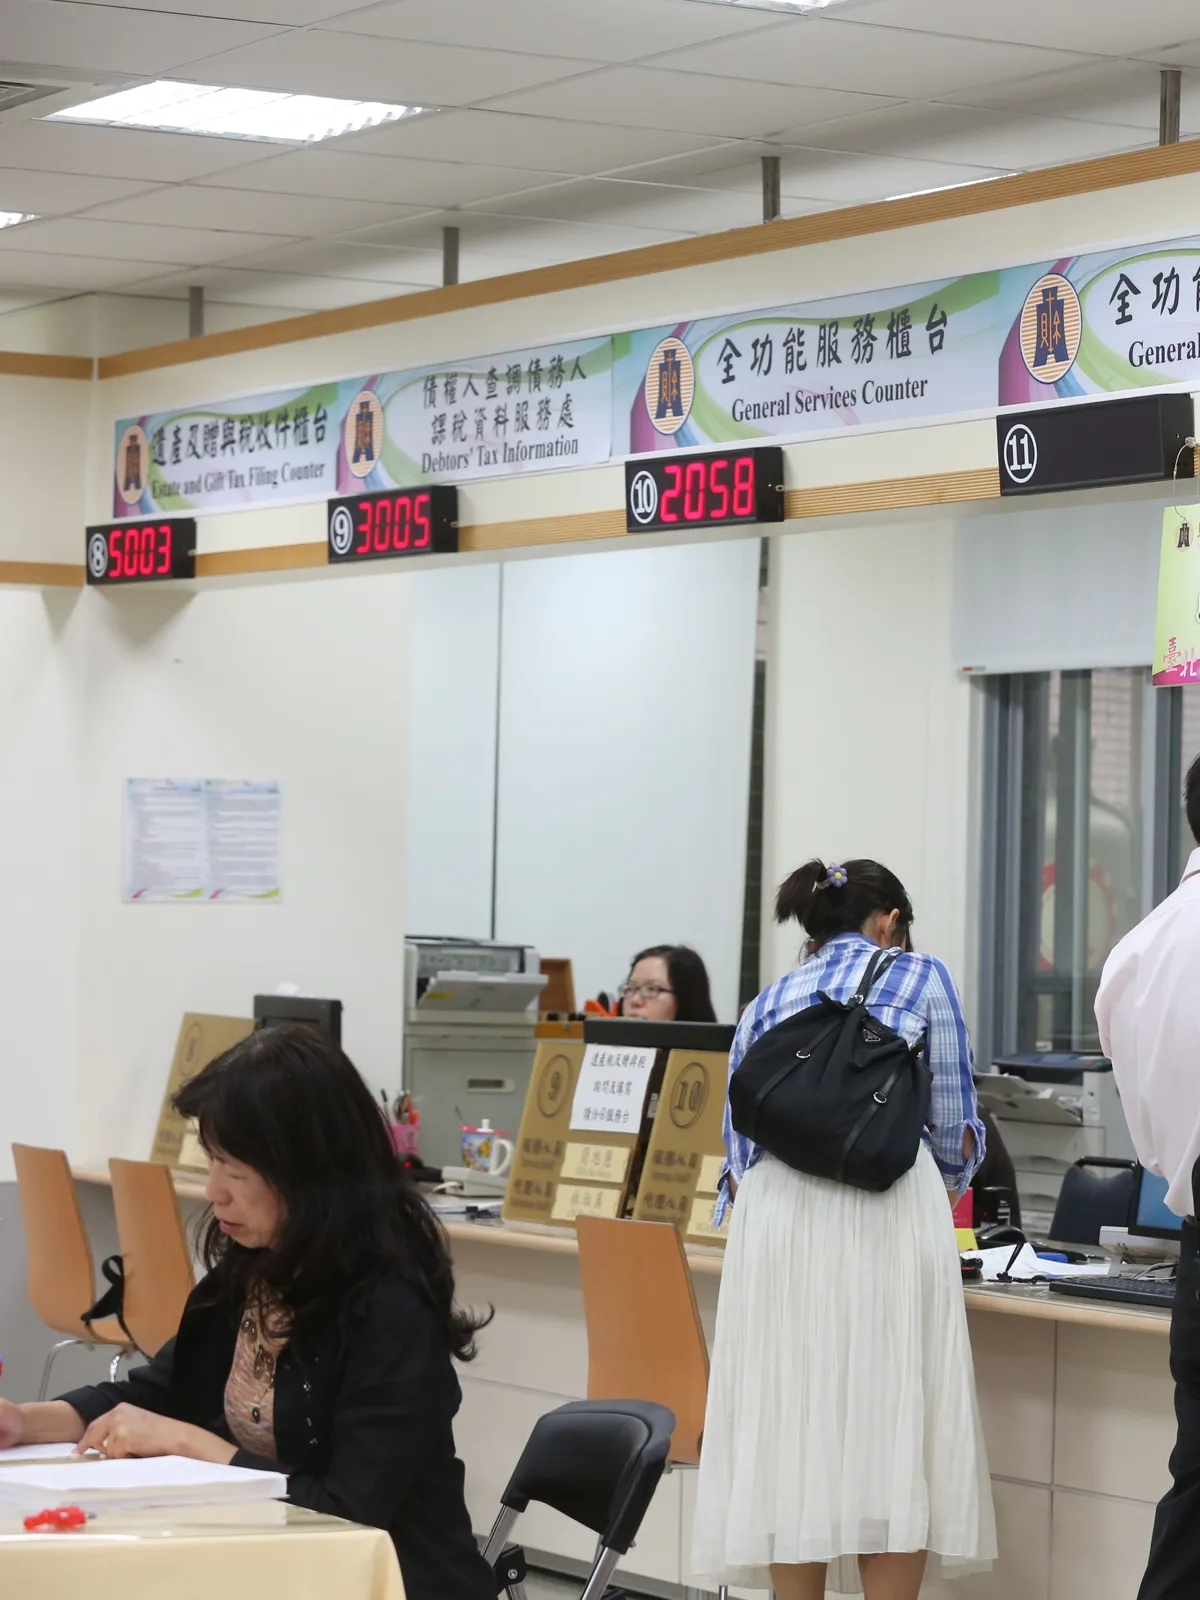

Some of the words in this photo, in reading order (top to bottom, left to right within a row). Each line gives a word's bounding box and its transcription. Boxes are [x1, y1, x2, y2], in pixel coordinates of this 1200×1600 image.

[716, 303, 948, 385] 全功能服務櫃台
[422, 354, 587, 409] 債權人查調債務人
[731, 392, 791, 422] General
[794, 386, 857, 414] Services
[861, 376, 929, 405] Counter
[152, 403, 328, 467] 遺產及贈與稅收件櫃台
[431, 393, 575, 446] 課稅資料服務處
[183, 476, 201, 494] and
[204, 471, 225, 492] Gift
[227, 470, 245, 490] Tax
[249, 466, 279, 489] Filing
[281, 462, 326, 483] Counter
[421, 447, 474, 474] Debtors'
[477, 445, 499, 467] Tax
[502, 434, 579, 464] Information
[1007, 429, 1035, 475] 11
[660, 456, 755, 523] 2058
[355, 494, 431, 554] 3005
[108, 524, 172, 578] 5003
[674, 1079, 705, 1112] 10
